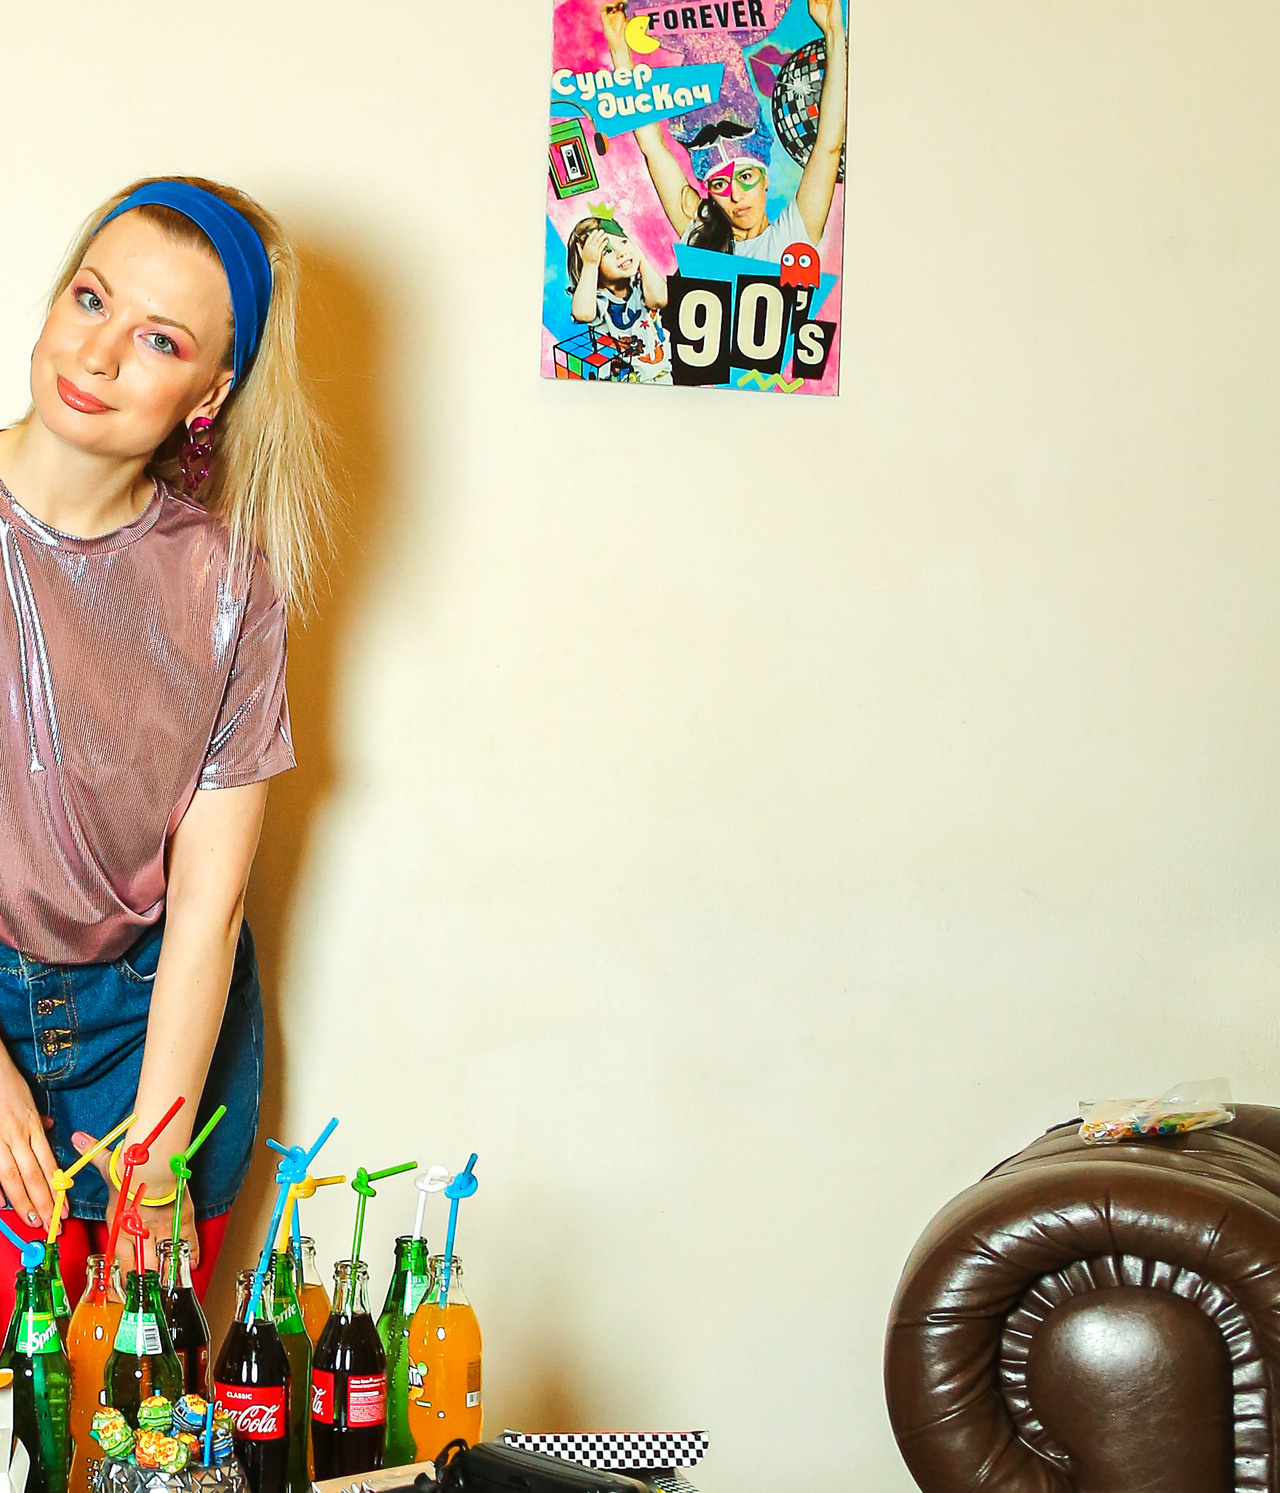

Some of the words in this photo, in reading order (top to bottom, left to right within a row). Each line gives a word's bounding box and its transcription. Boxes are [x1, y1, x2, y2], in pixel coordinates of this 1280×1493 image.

[647, 0, 766, 31] FOREVER
[552, 62, 653, 101] Супер
[676, 282, 825, 368] 90's
[273, 1303, 297, 1332] prite
[226, 1391, 253, 1400] CLASSIC
